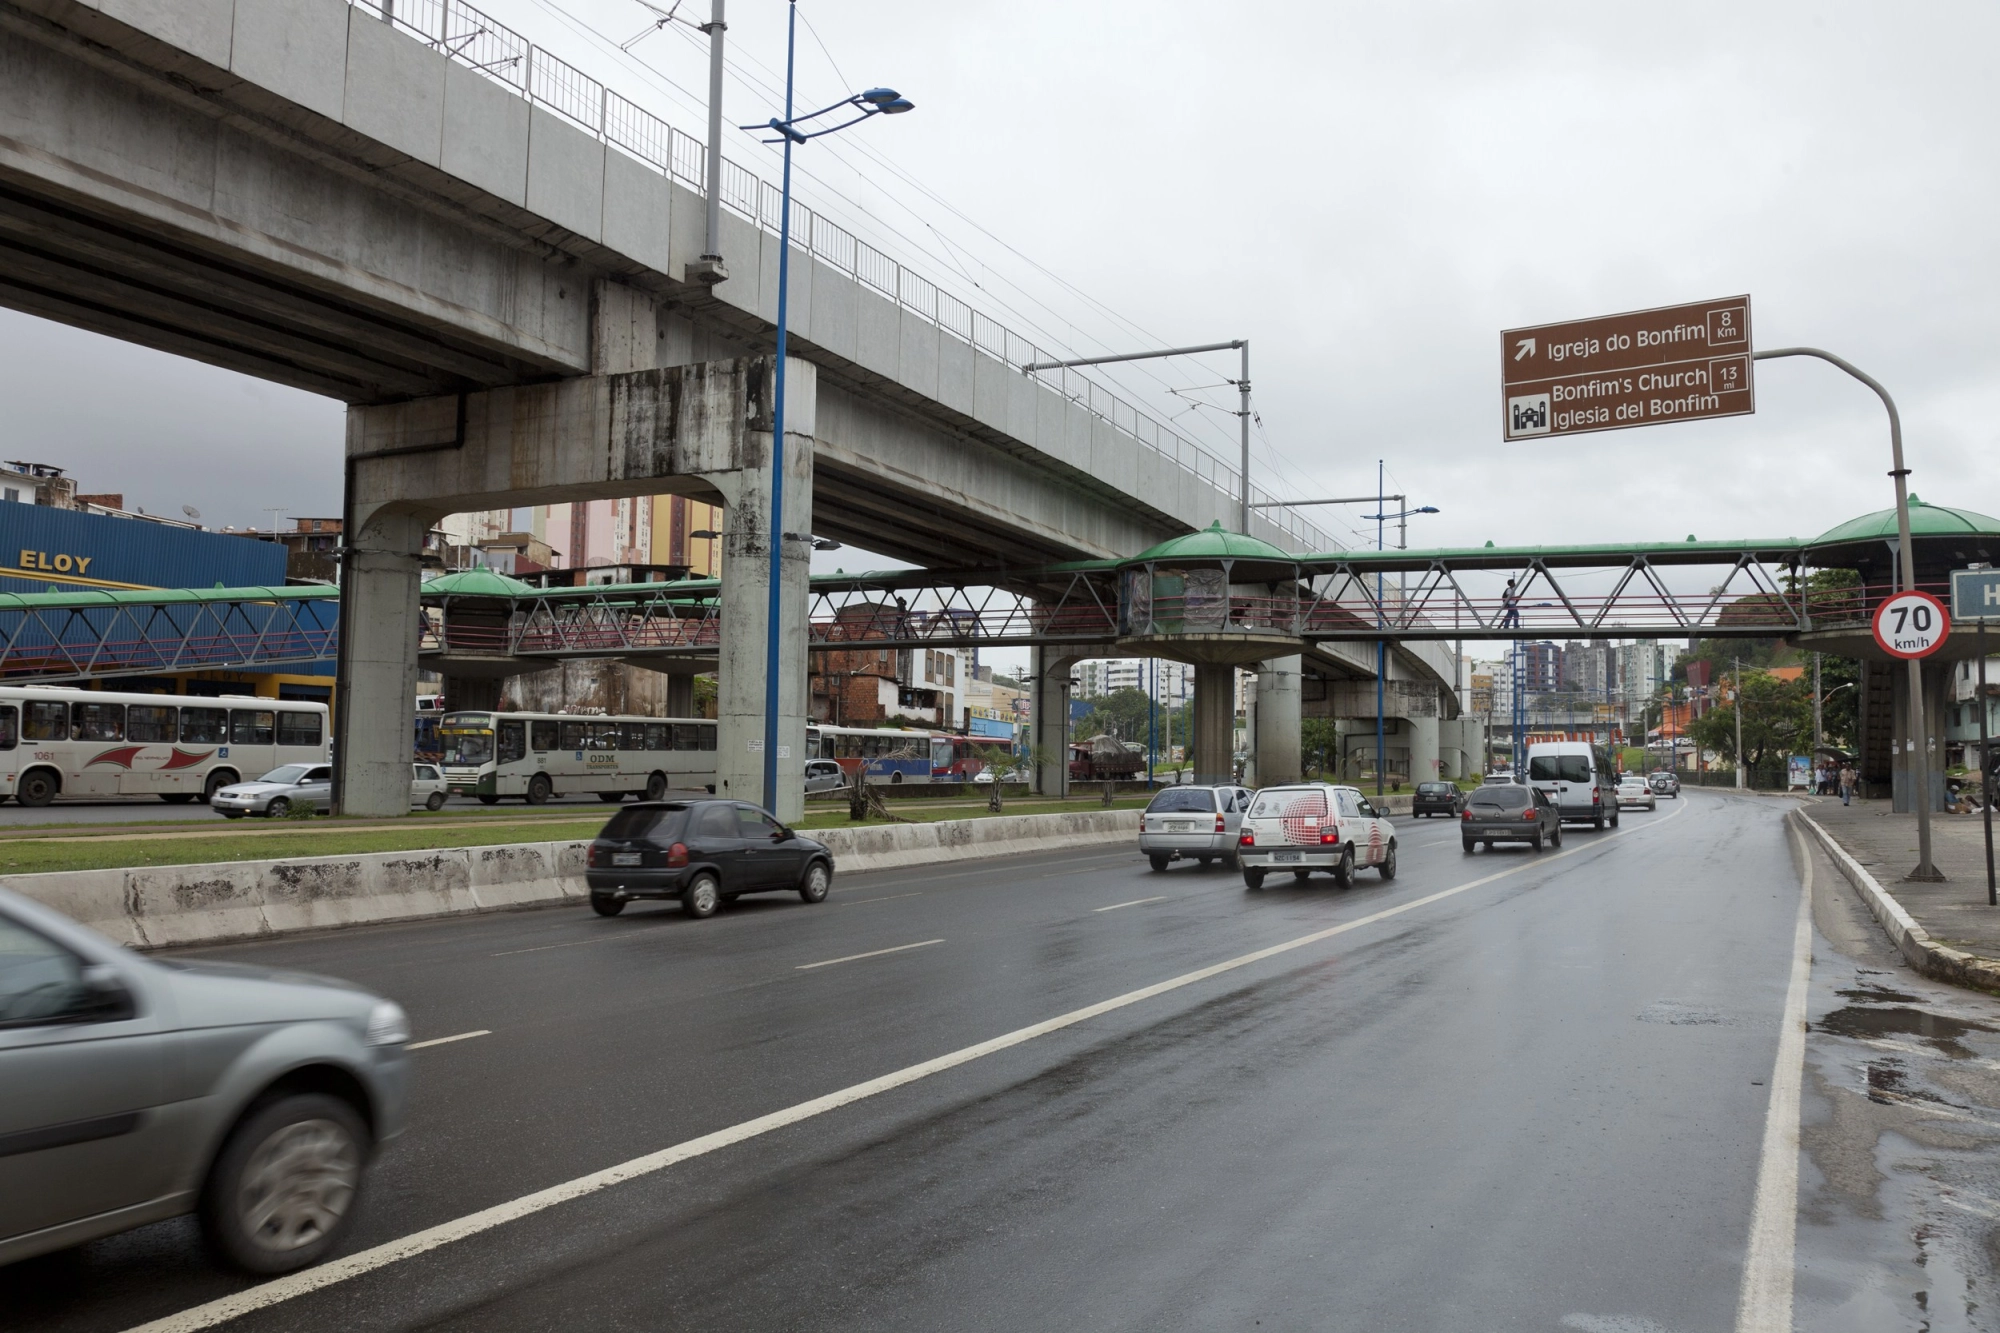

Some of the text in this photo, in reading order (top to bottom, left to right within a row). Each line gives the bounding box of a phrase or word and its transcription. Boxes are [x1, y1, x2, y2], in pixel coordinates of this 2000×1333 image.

[1721, 312, 1731, 326] 8
[1717, 327, 1736, 338] Km
[1548, 323, 1705, 361] Igreja do Bonfim
[1720, 366, 1737, 380] 13
[1553, 368, 1707, 402] Bonfim's Church
[1553, 393, 1719, 430] Iglesia del Bonfim
[19, 549, 92, 574] ELOY
[1890, 605, 1932, 634] 70
[1894, 637, 1929, 649] km/h
[33, 752, 55, 760] 1061
[590, 755, 615, 763] ODM
